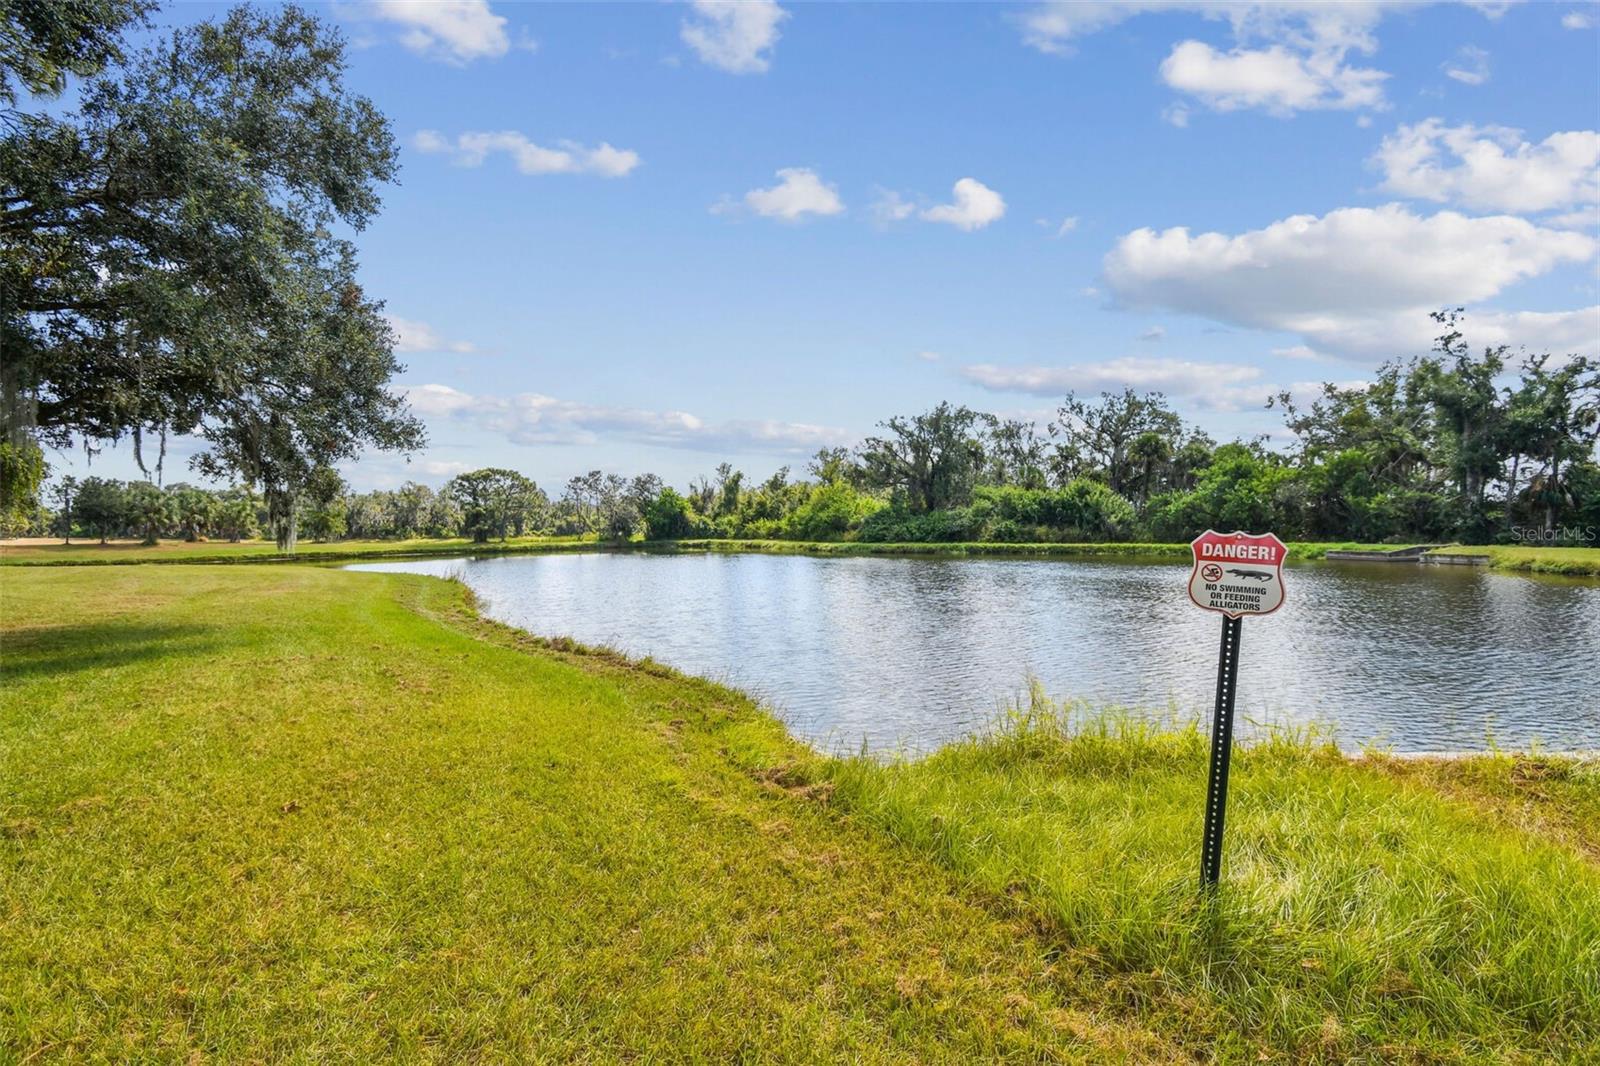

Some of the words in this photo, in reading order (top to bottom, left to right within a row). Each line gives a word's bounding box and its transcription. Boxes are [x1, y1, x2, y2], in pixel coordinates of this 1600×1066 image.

[1202, 543, 1276, 560] DANGER!
[1206, 583, 1217, 591] NO
[1219, 584, 1267, 595] SWIMMING
[1210, 592, 1222, 600] OR
[1224, 593, 1260, 603] FEEDING
[1209, 600, 1260, 611] ALLIGATORS
